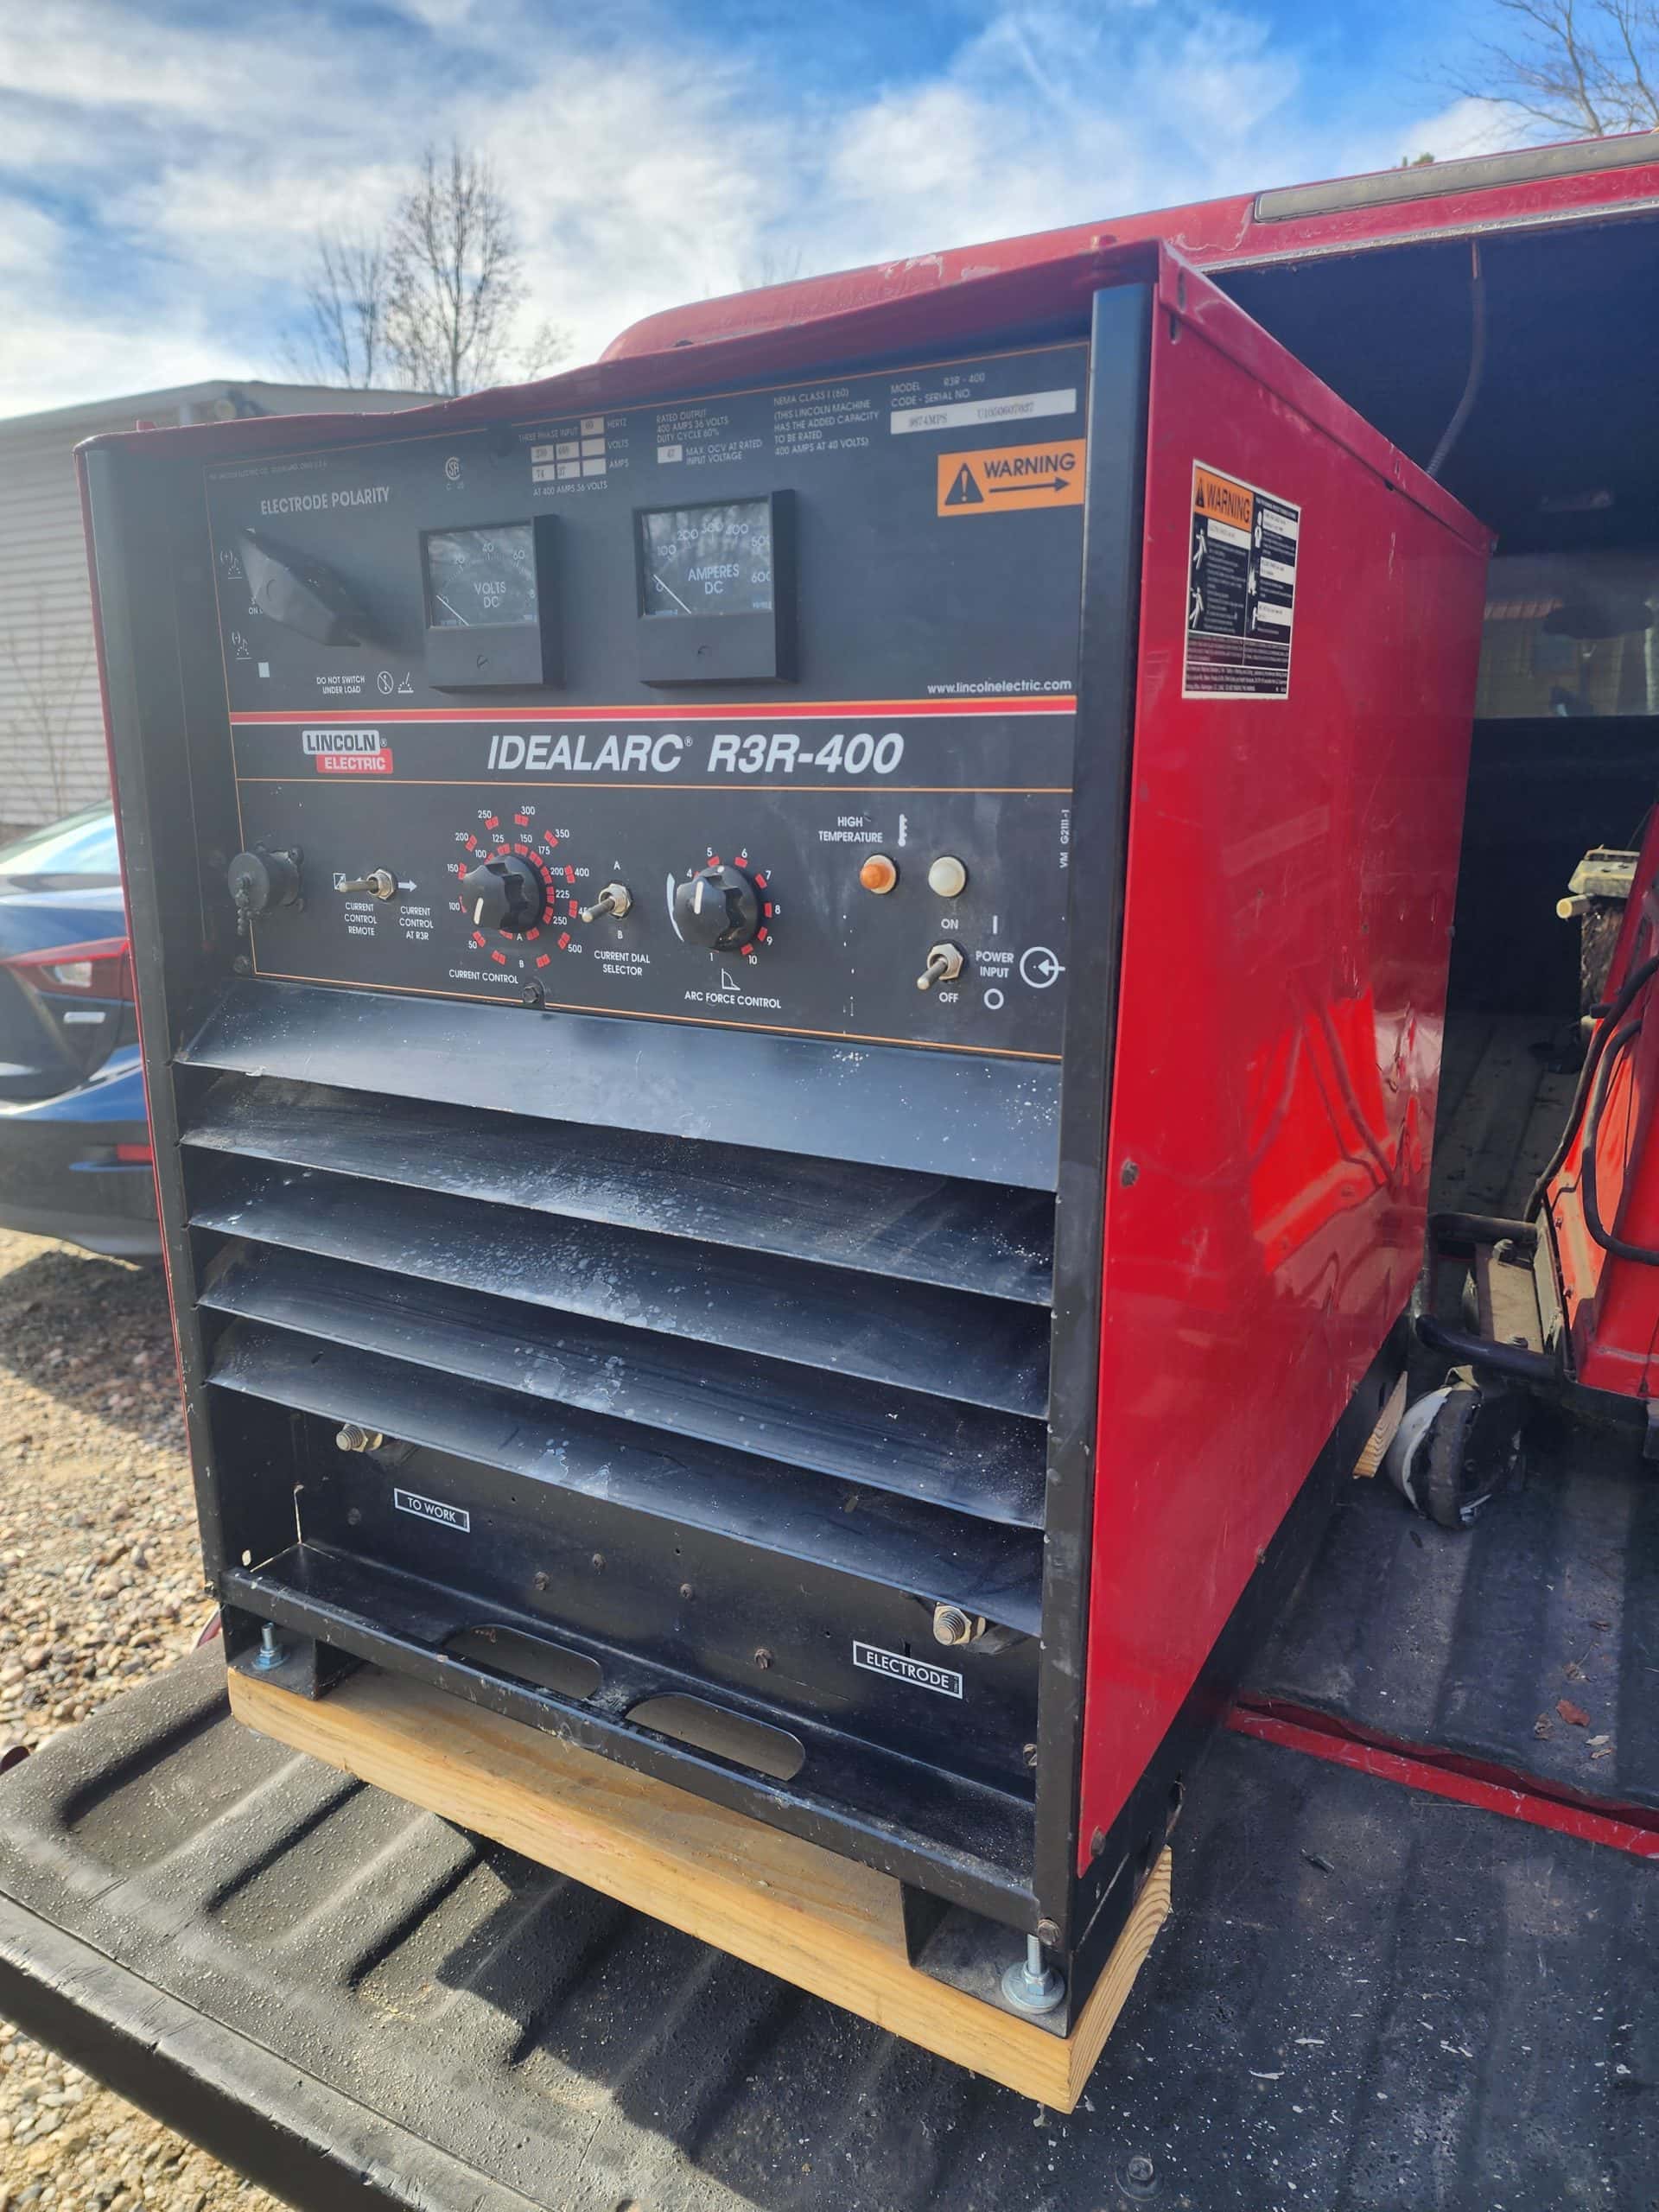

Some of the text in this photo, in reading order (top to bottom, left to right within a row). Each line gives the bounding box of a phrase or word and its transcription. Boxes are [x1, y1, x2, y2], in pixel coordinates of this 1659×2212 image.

[891, 381, 920, 395] MODEL
[969, 372, 985, 384] 400
[798, 391, 825, 403] CLASS
[891, 395, 918, 407] CODE
[925, 391, 953, 404] SERIAL
[795, 405, 830, 418] LINCOLN
[832, 399, 871, 412] MACHINE
[657, 408, 706, 423] RATED OUTPUT
[792, 420, 805, 430] THE
[808, 416, 836, 429] ADDED
[836, 410, 879, 424] CAPACITY
[672, 421, 692, 431] AMPS
[706, 416, 728, 427] VOLTS
[657, 433, 675, 443] DUTY
[677, 430, 702, 442] CYCLE
[774, 430, 822, 444] TO BE RATED
[607, 439, 629, 450] VOLTS
[739, 438, 762, 449] RATED
[791, 442, 814, 454] AMPS
[817, 441, 825, 450] AT
[609, 457, 630, 468] AMPS
[686, 450, 742, 466] INPUT VOLTAGE
[983, 453, 1076, 479] WARNING
[532, 486, 543, 497] AT
[588, 480, 608, 492] VOLTS
[260, 486, 390, 515] ELECTRODE POLARITY
[1206, 483, 1250, 524] WARNING
[677, 528, 698, 541] 200
[725, 524, 749, 536] 400
[513, 549, 525, 560] 60
[657, 544, 677, 556] 100
[688, 563, 740, 582] AMPERES
[474, 582, 506, 594] VOLTS
[704, 581, 724, 594] DC
[484, 596, 500, 608] DC
[328, 676, 340, 684] NOT
[342, 675, 365, 684] SWITCH
[344, 685, 360, 694] LOAD
[927, 678, 1071, 695] www.lincolnelectric.com
[707, 732, 905, 775] R3R-400
[324, 756, 386, 771] ELECTRIC
[478, 810, 492, 819] 250
[521, 806, 535, 816] 300
[837, 816, 863, 827] HIGH
[455, 832, 469, 842] 200
[493, 834, 505, 843] 125
[520, 834, 532, 843] 150
[555, 830, 570, 839] 350
[818, 830, 883, 843] TEMPERATURE
[474, 849, 486, 858] 100
[538, 845, 550, 855] 175
[707, 848, 713, 856] 5
[741, 849, 747, 858] 6
[1059, 851, 1069, 868] VM
[447, 864, 459, 873] 150
[613, 861, 620, 870] A
[550, 867, 564, 876] 200
[575, 868, 589, 877] 400
[686, 868, 692, 878] 4
[766, 870, 772, 880] 7
[556, 889, 570, 899] 225
[346, 901, 374, 912] CURRENT
[400, 906, 431, 916] CURRENT
[448, 901, 461, 911] 100
[774, 905, 781, 914] 8
[344, 913, 378, 925] CONTROL
[399, 918, 434, 929] CONTROL
[553, 916, 568, 925] 250
[941, 918, 959, 930] ON
[348, 925, 375, 936] REMOTE
[406, 931, 429, 940] AT R3R
[617, 930, 623, 939] B
[468, 940, 477, 949] 50
[766, 936, 773, 945] 9
[568, 944, 582, 953] 500
[594, 950, 651, 963] CURRENT DIAL
[709, 952, 714, 962] 1
[748, 955, 758, 965] 10
[976, 950, 1014, 963] POWER
[519, 960, 524, 969] B
[602, 963, 643, 976] SELECTOR
[448, 969, 518, 984] CURRENT CONTROL
[980, 965, 1009, 978] INPUT
[684, 990, 781, 1008] ARC FORCE CONTROL
[939, 992, 959, 1003] OFF
[407, 1497, 423, 1511] TO
[423, 1503, 456, 1522] WORK
[866, 1651, 950, 1689] ELECTRODE
